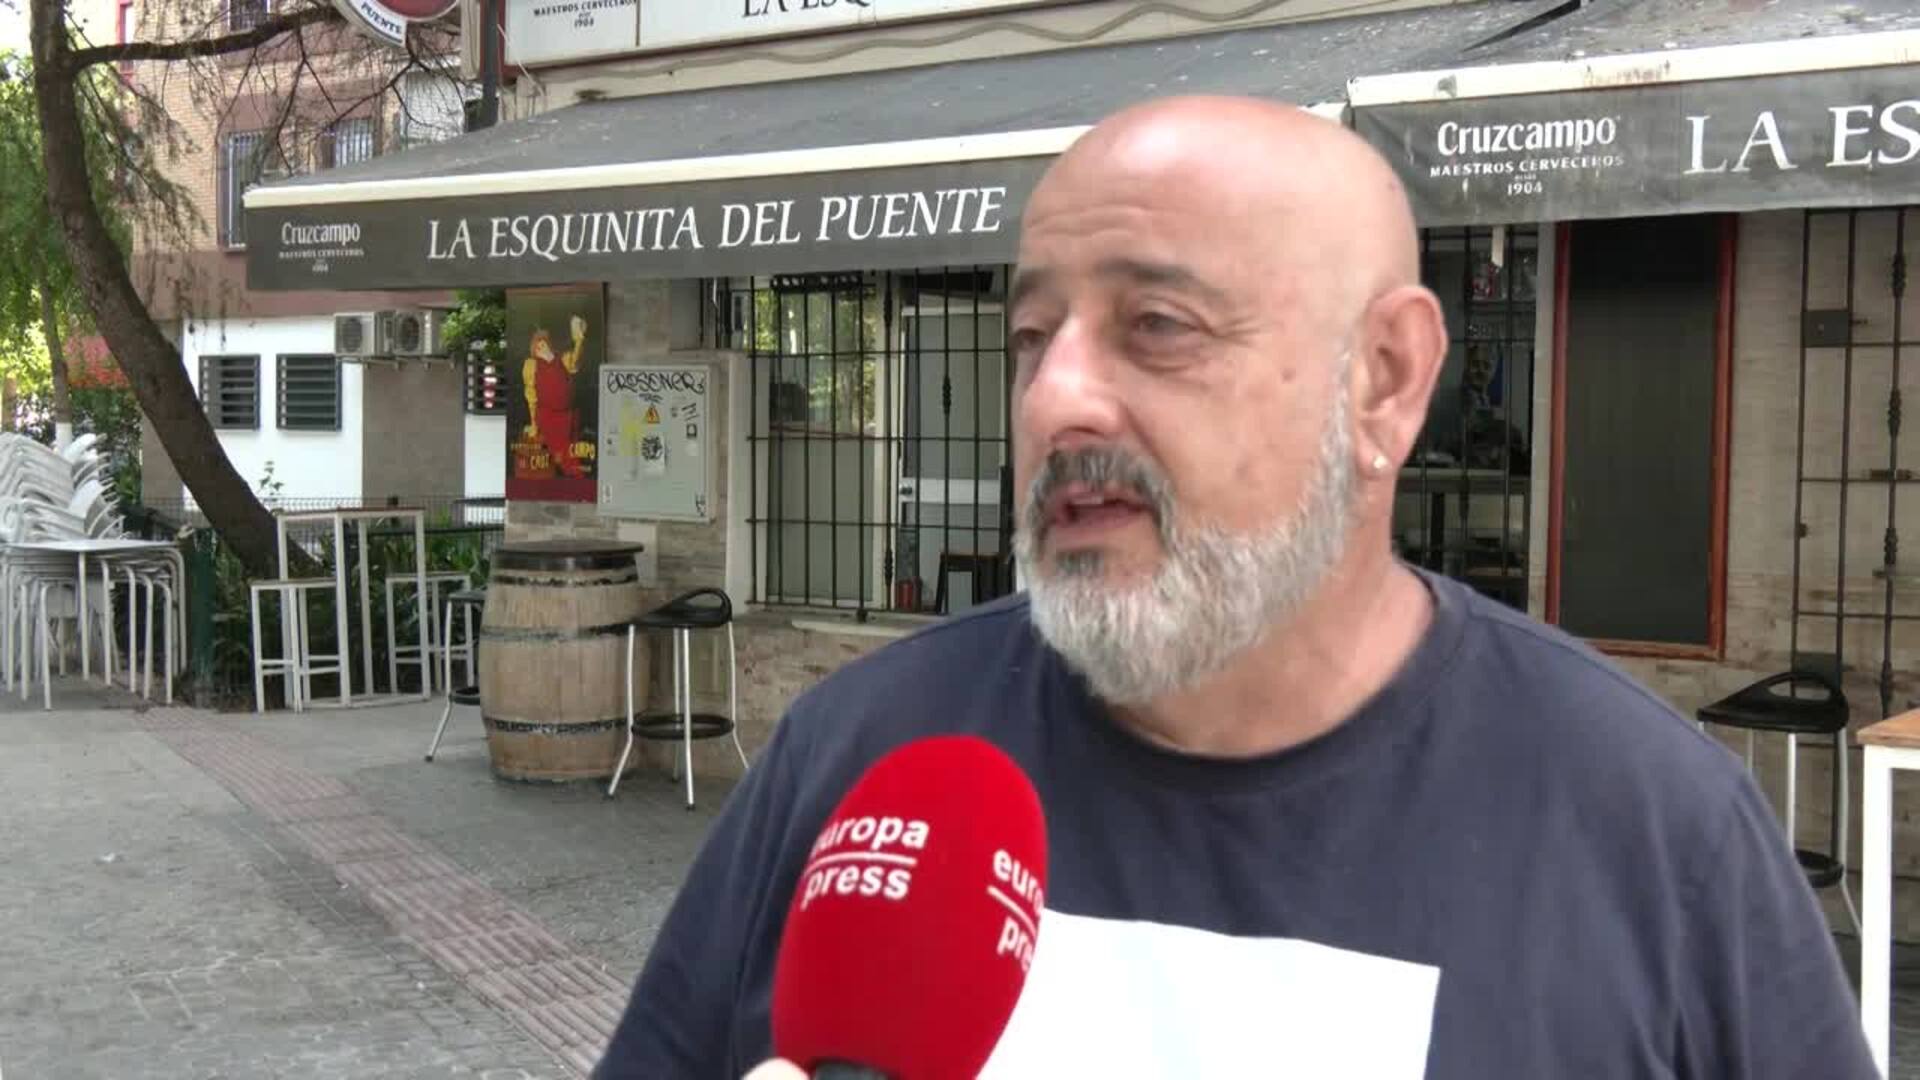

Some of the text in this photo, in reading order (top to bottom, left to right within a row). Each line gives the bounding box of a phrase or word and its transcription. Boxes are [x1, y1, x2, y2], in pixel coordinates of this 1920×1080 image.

[361, 3, 403, 33] PUENTE
[1437, 116, 1617, 156] Cruzcampo
[1683, 110, 1799, 175] LA
[1429, 162, 1514, 178] MAESTROS
[1507, 181, 1543, 196] 1904
[282, 222, 361, 246] Cruzcampo
[427, 186, 1006, 261] LA ESQUINITA DEL PUENTE
[800, 866, 911, 911] press
